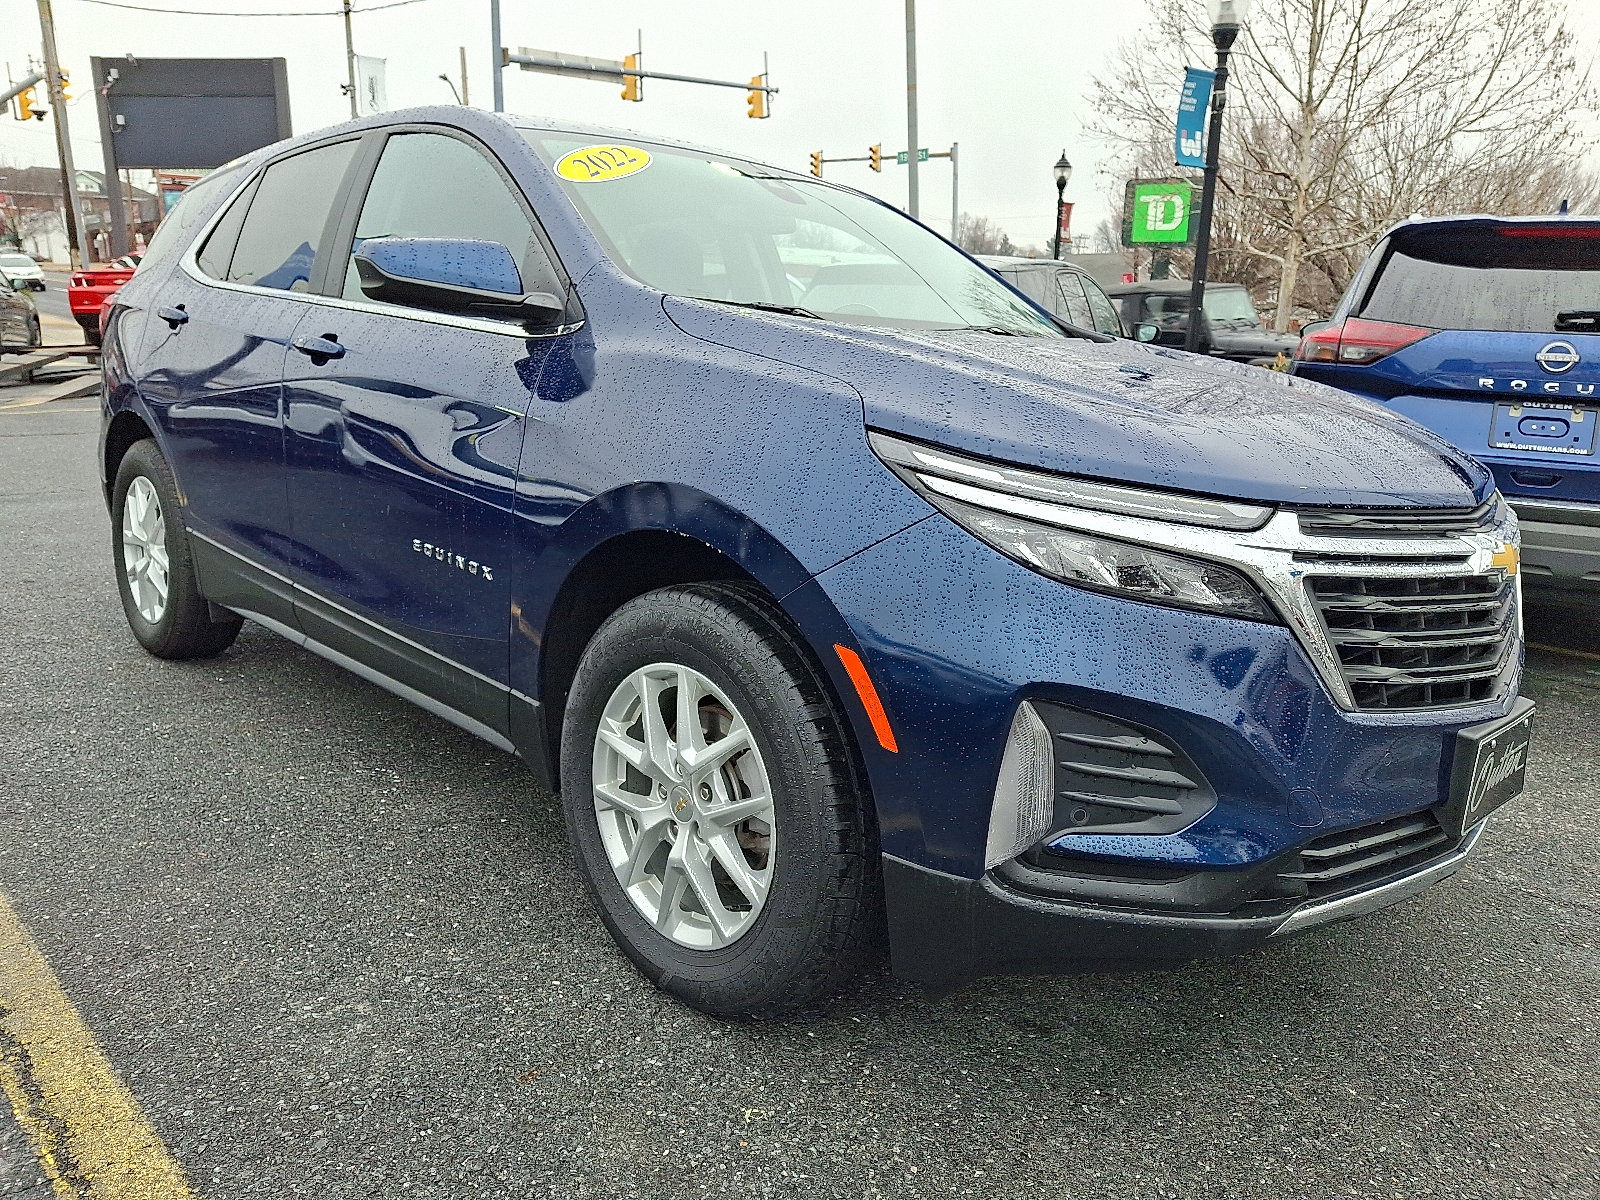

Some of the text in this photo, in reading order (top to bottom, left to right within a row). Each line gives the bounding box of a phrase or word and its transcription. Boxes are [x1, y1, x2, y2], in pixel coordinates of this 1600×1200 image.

[572, 147, 637, 177] 2022
[1140, 195, 1184, 231] TD
[1478, 378, 1595, 394] ROGU
[1522, 401, 1573, 410] OUTTEN
[1496, 442, 1588, 455] WWW.OUTTENCARS.COM
[412, 538, 494, 581] EQUINOX
